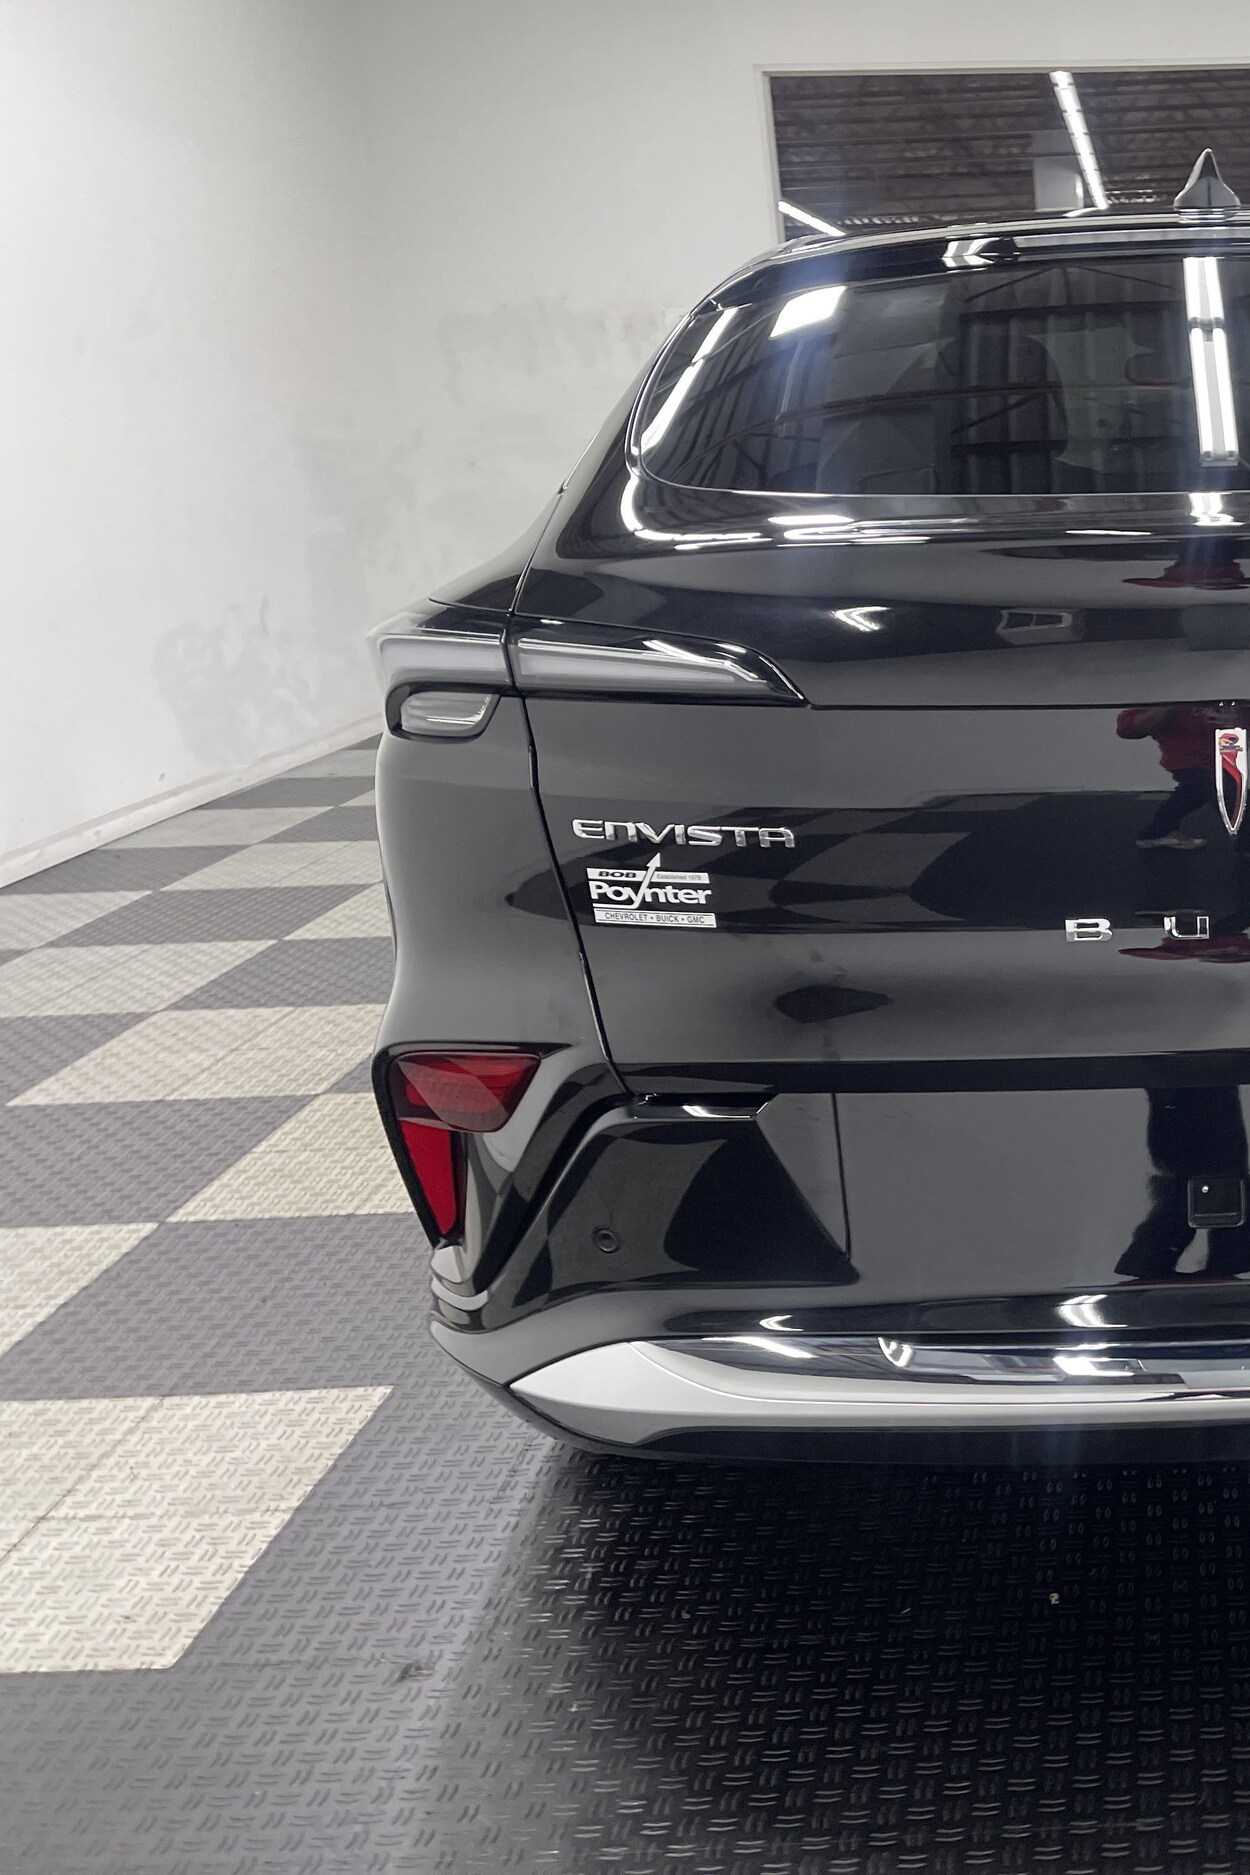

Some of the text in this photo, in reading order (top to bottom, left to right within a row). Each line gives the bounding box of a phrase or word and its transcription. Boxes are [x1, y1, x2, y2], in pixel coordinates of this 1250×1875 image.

[572, 818, 796, 849] ENVISTA
[588, 880, 712, 905] Poynter
[604, 912, 705, 925] CHEVROLET BUICK GMC
